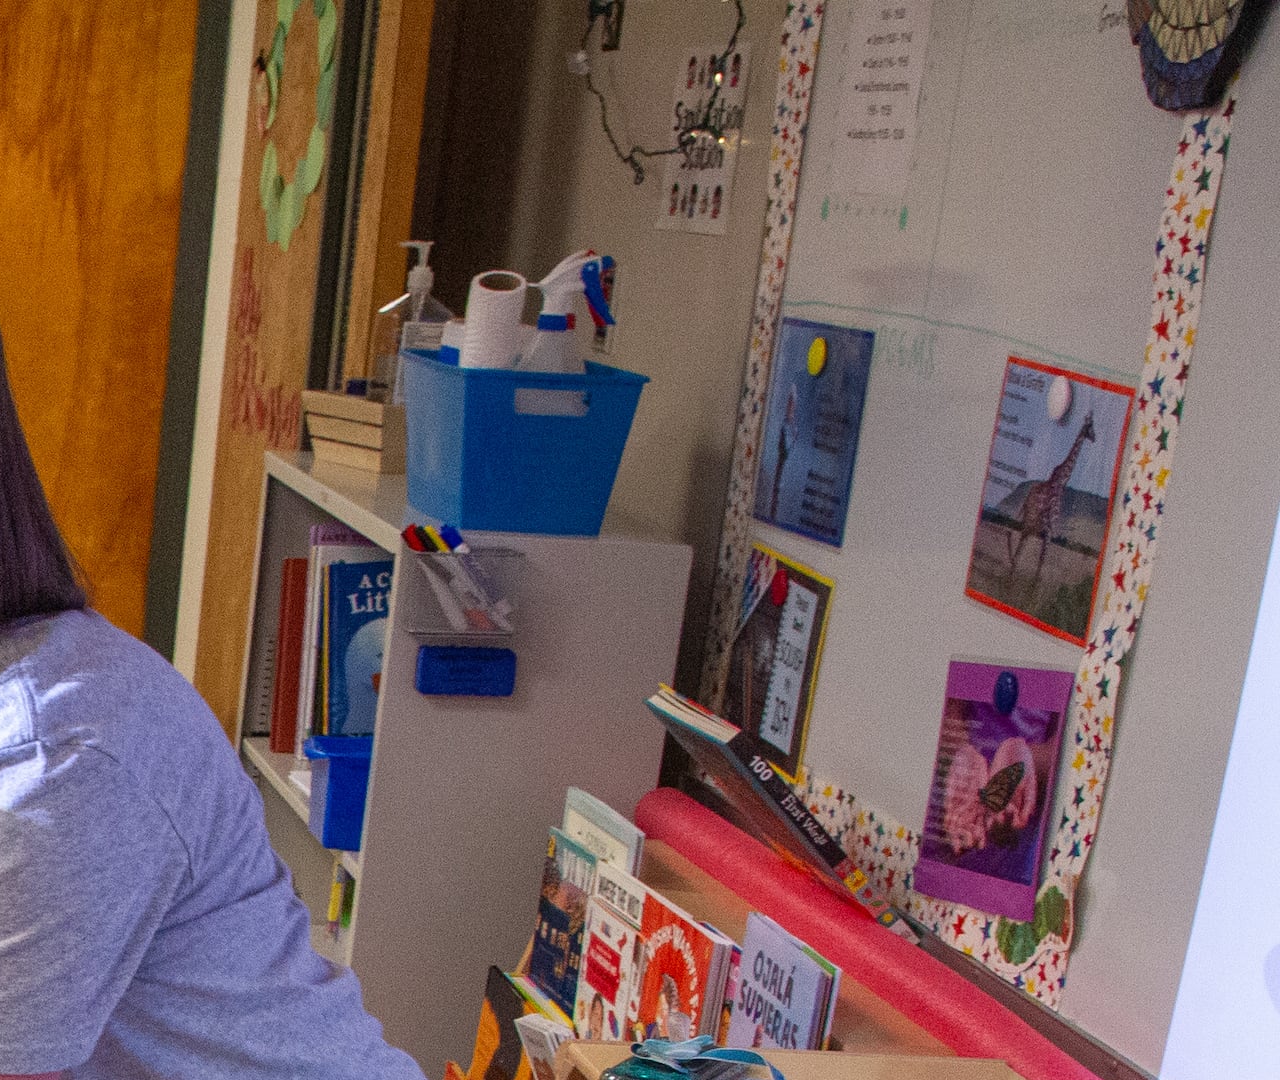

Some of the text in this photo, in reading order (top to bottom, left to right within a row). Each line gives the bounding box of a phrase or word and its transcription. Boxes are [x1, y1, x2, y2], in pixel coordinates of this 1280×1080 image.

[359, 571, 393, 588] A C
[749, 755, 774, 781] 100
[753, 950, 797, 1009] OJALÁ
[738, 979, 799, 1049] SUPIERAS
